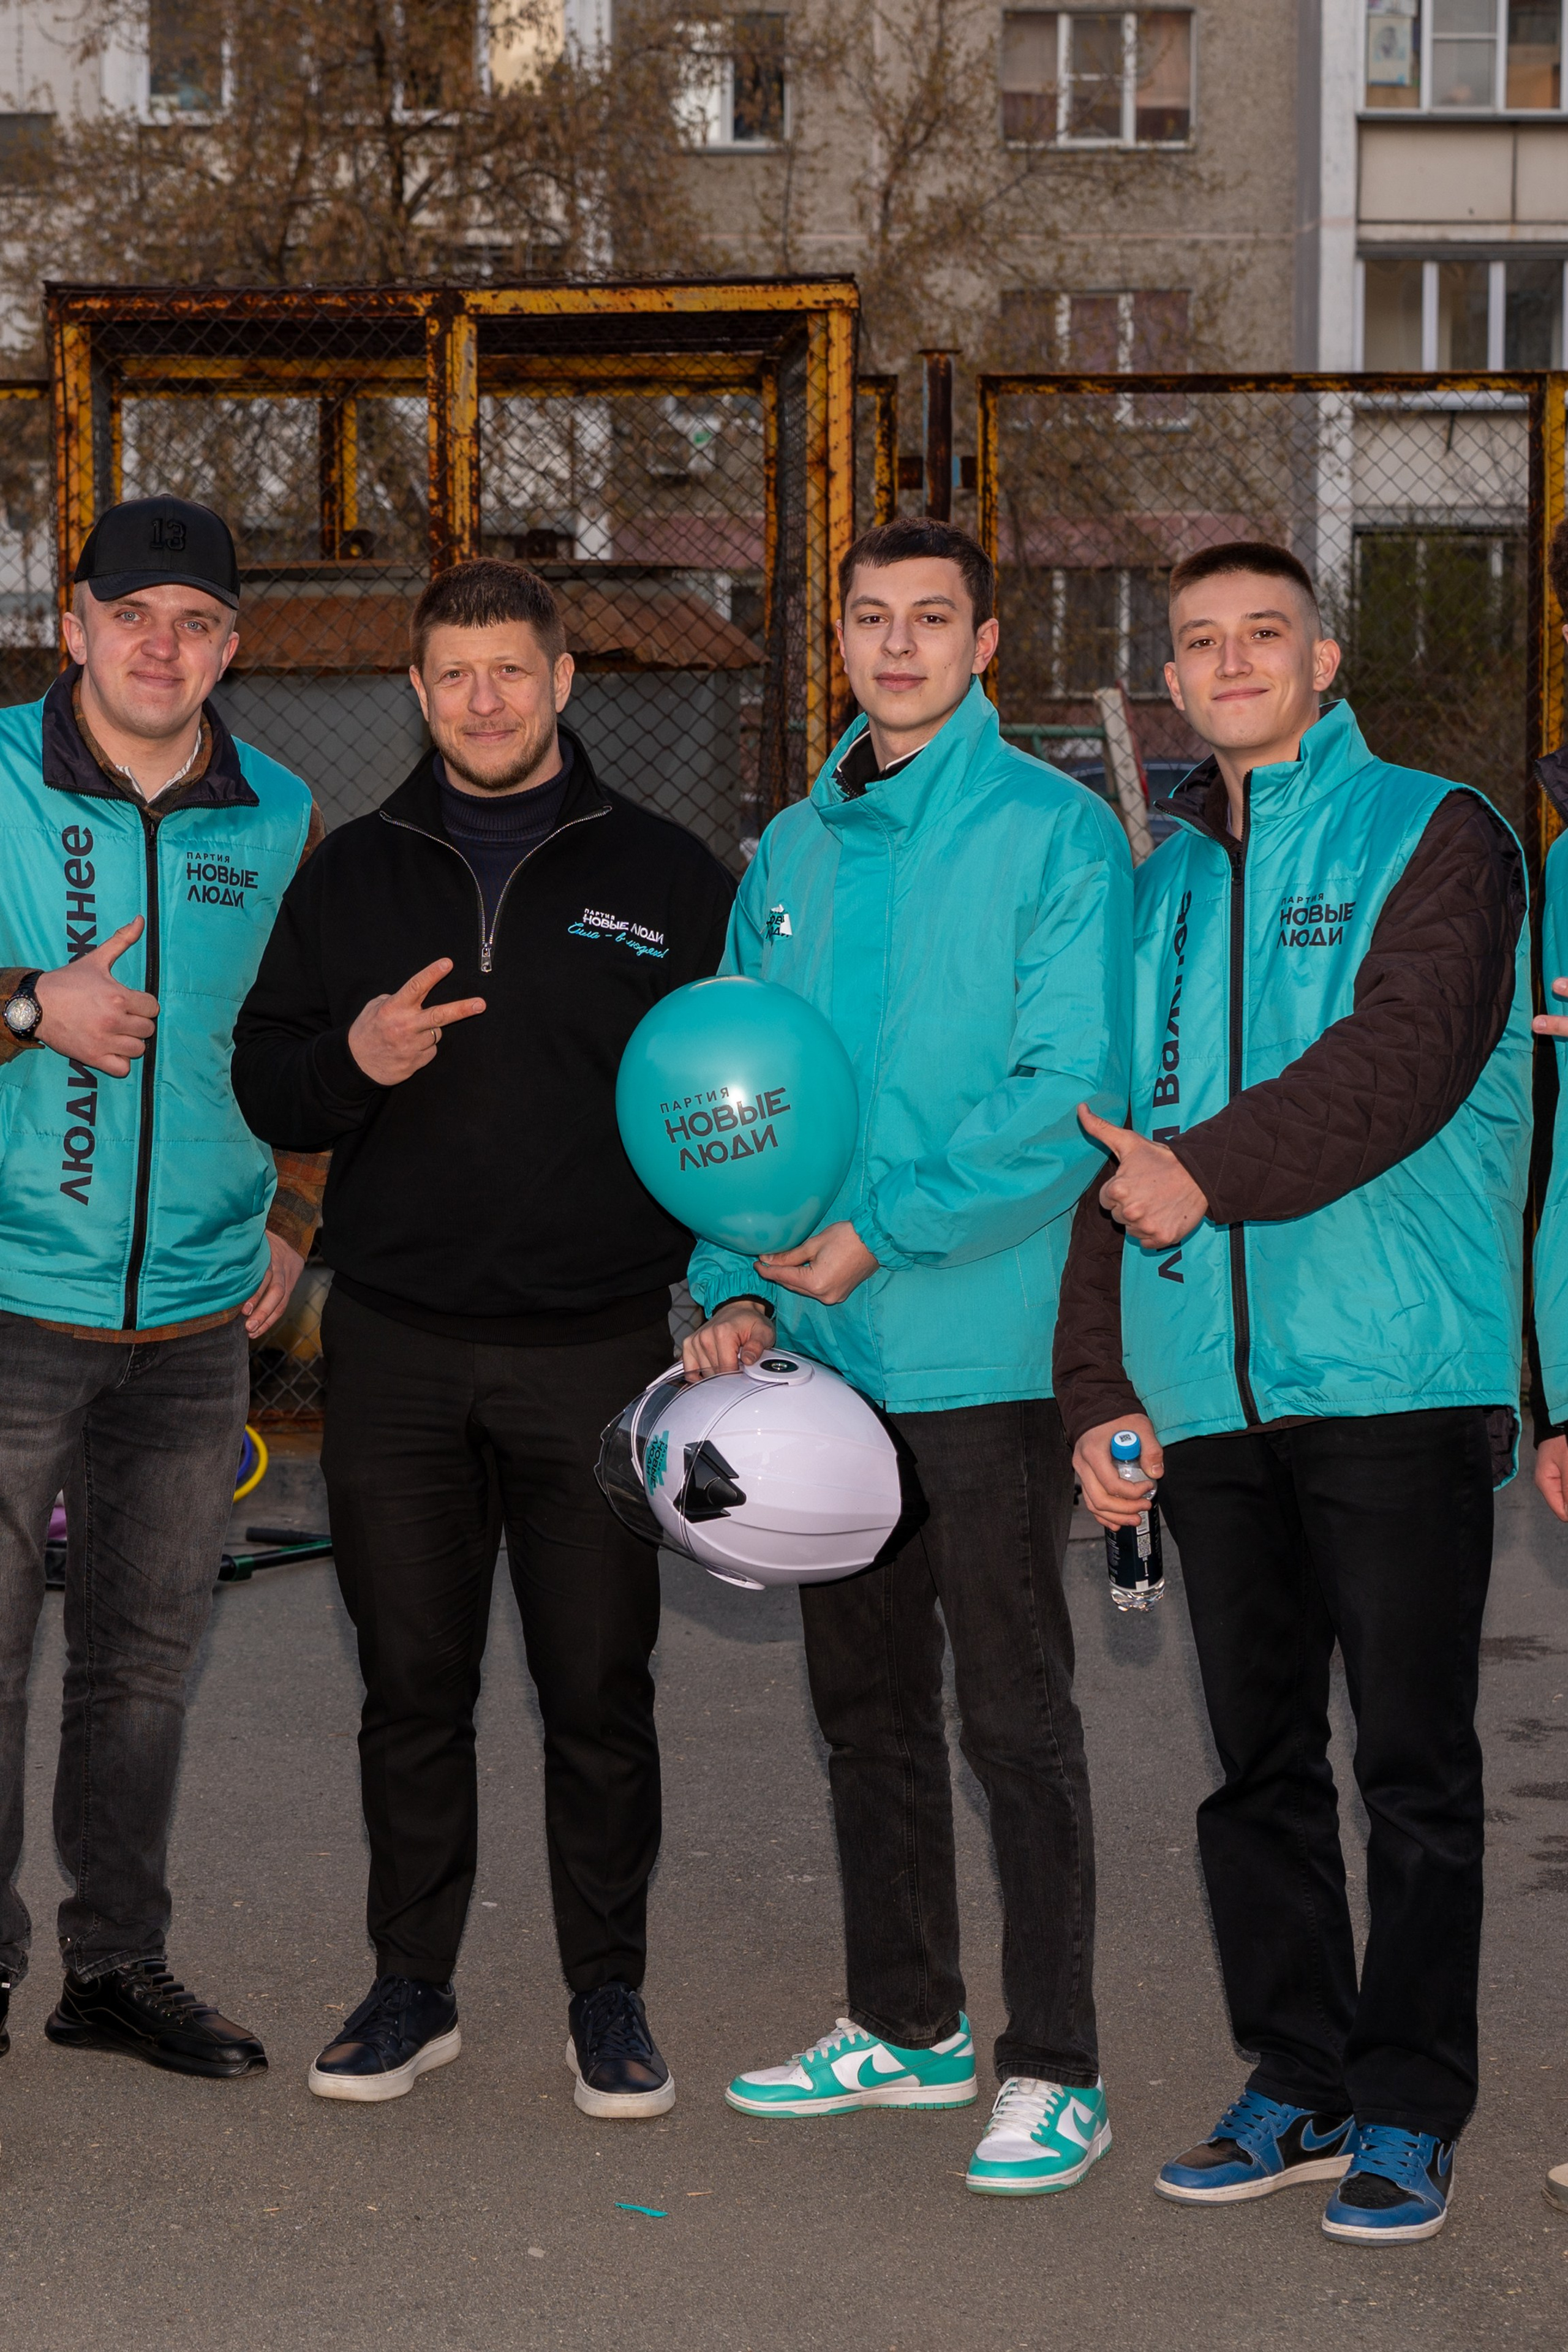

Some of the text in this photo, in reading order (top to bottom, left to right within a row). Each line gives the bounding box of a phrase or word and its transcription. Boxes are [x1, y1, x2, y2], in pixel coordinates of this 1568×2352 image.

[151, 519, 186, 551] 13
[187, 852, 230, 863] ПАРТИЯ
[187, 862, 258, 889] НОВЫЕ
[187, 884, 244, 909] ЛЮДИ
[1281, 893, 1324, 906] ПАРТИЯ
[584, 908, 615, 920] ПАРТИЯ
[1280, 901, 1356, 927] НОВЫЕ
[568, 921, 601, 939] Сила
[615, 932, 626, 942] в
[626, 940, 669, 958] людях!
[582, 914, 664, 944] НОВЫЕ ЛЮДИ
[1276, 926, 1343, 949] ЛЮДИ
[660, 1087, 729, 1114] ПАРТИЯ
[665, 1087, 791, 1143] НОВЫЕ
[680, 1124, 778, 1170] ЛЮДИ
[650, 1440, 665, 1488] НОВЫЕ
